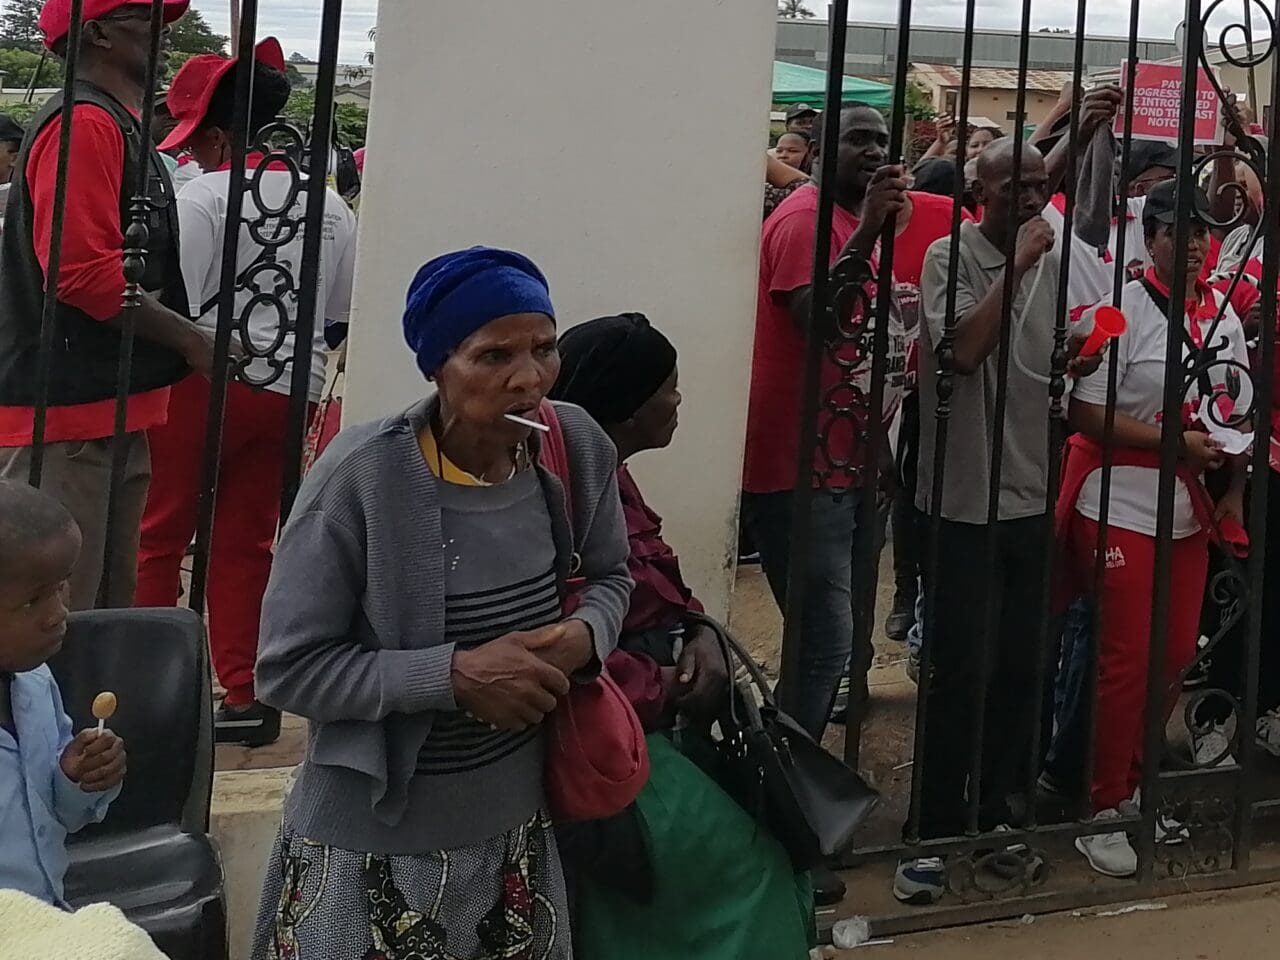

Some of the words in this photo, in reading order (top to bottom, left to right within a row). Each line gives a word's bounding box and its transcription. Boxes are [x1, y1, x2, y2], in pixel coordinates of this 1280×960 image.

[1161, 79, 1182, 89] PAY
[1200, 90, 1216, 100] TO
[1141, 97, 1210, 110] INTRODED
[1189, 109, 1215, 120] AST
